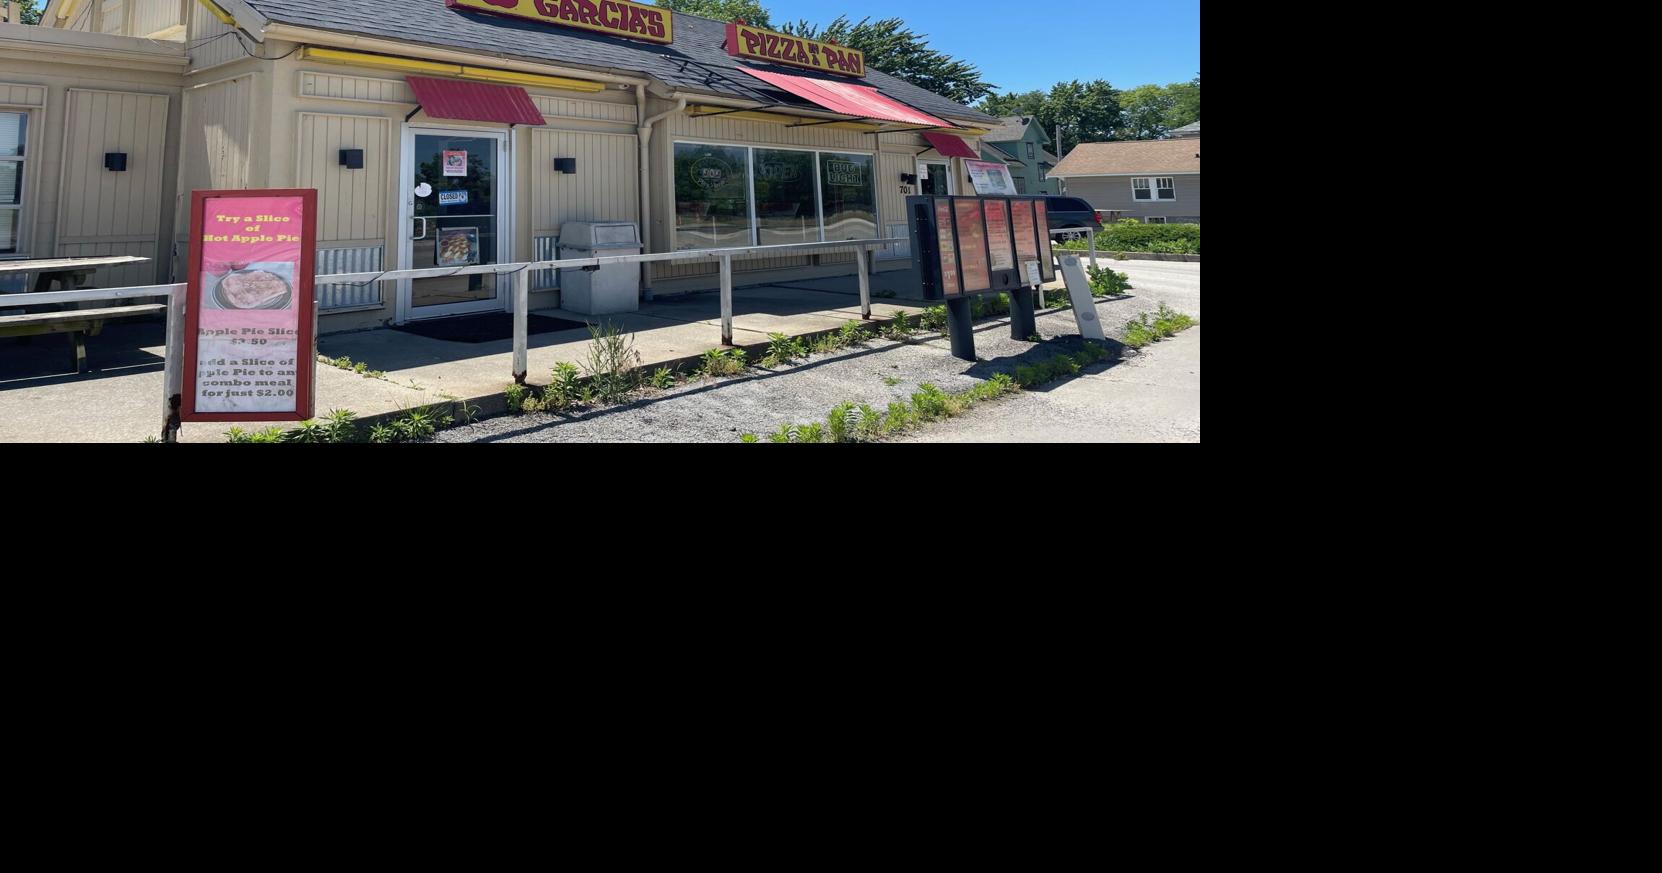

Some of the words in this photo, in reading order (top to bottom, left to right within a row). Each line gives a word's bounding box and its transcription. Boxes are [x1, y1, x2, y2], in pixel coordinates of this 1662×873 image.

[534, 0, 665, 38] GARCIA'S
[741, 29, 809, 64] PIZZA
[822, 46, 860, 74] PAN
[899, 186, 911, 194] 701
[216, 214, 241, 223] Try
[256, 214, 290, 222] Slice
[203, 234, 229, 242] Hot
[231, 234, 273, 243] Apple
[276, 234, 300, 242] Pie
[241, 327, 265, 335] Pie
[241, 358, 276, 366] Slice
[278, 358, 295, 366] of
[232, 368, 256, 376] Pie
[202, 379, 252, 387] combo
[254, 379, 292, 387] meal
[201, 389, 224, 397] for
[224, 389, 254, 398] just
[256, 389, 294, 397] $2.00
